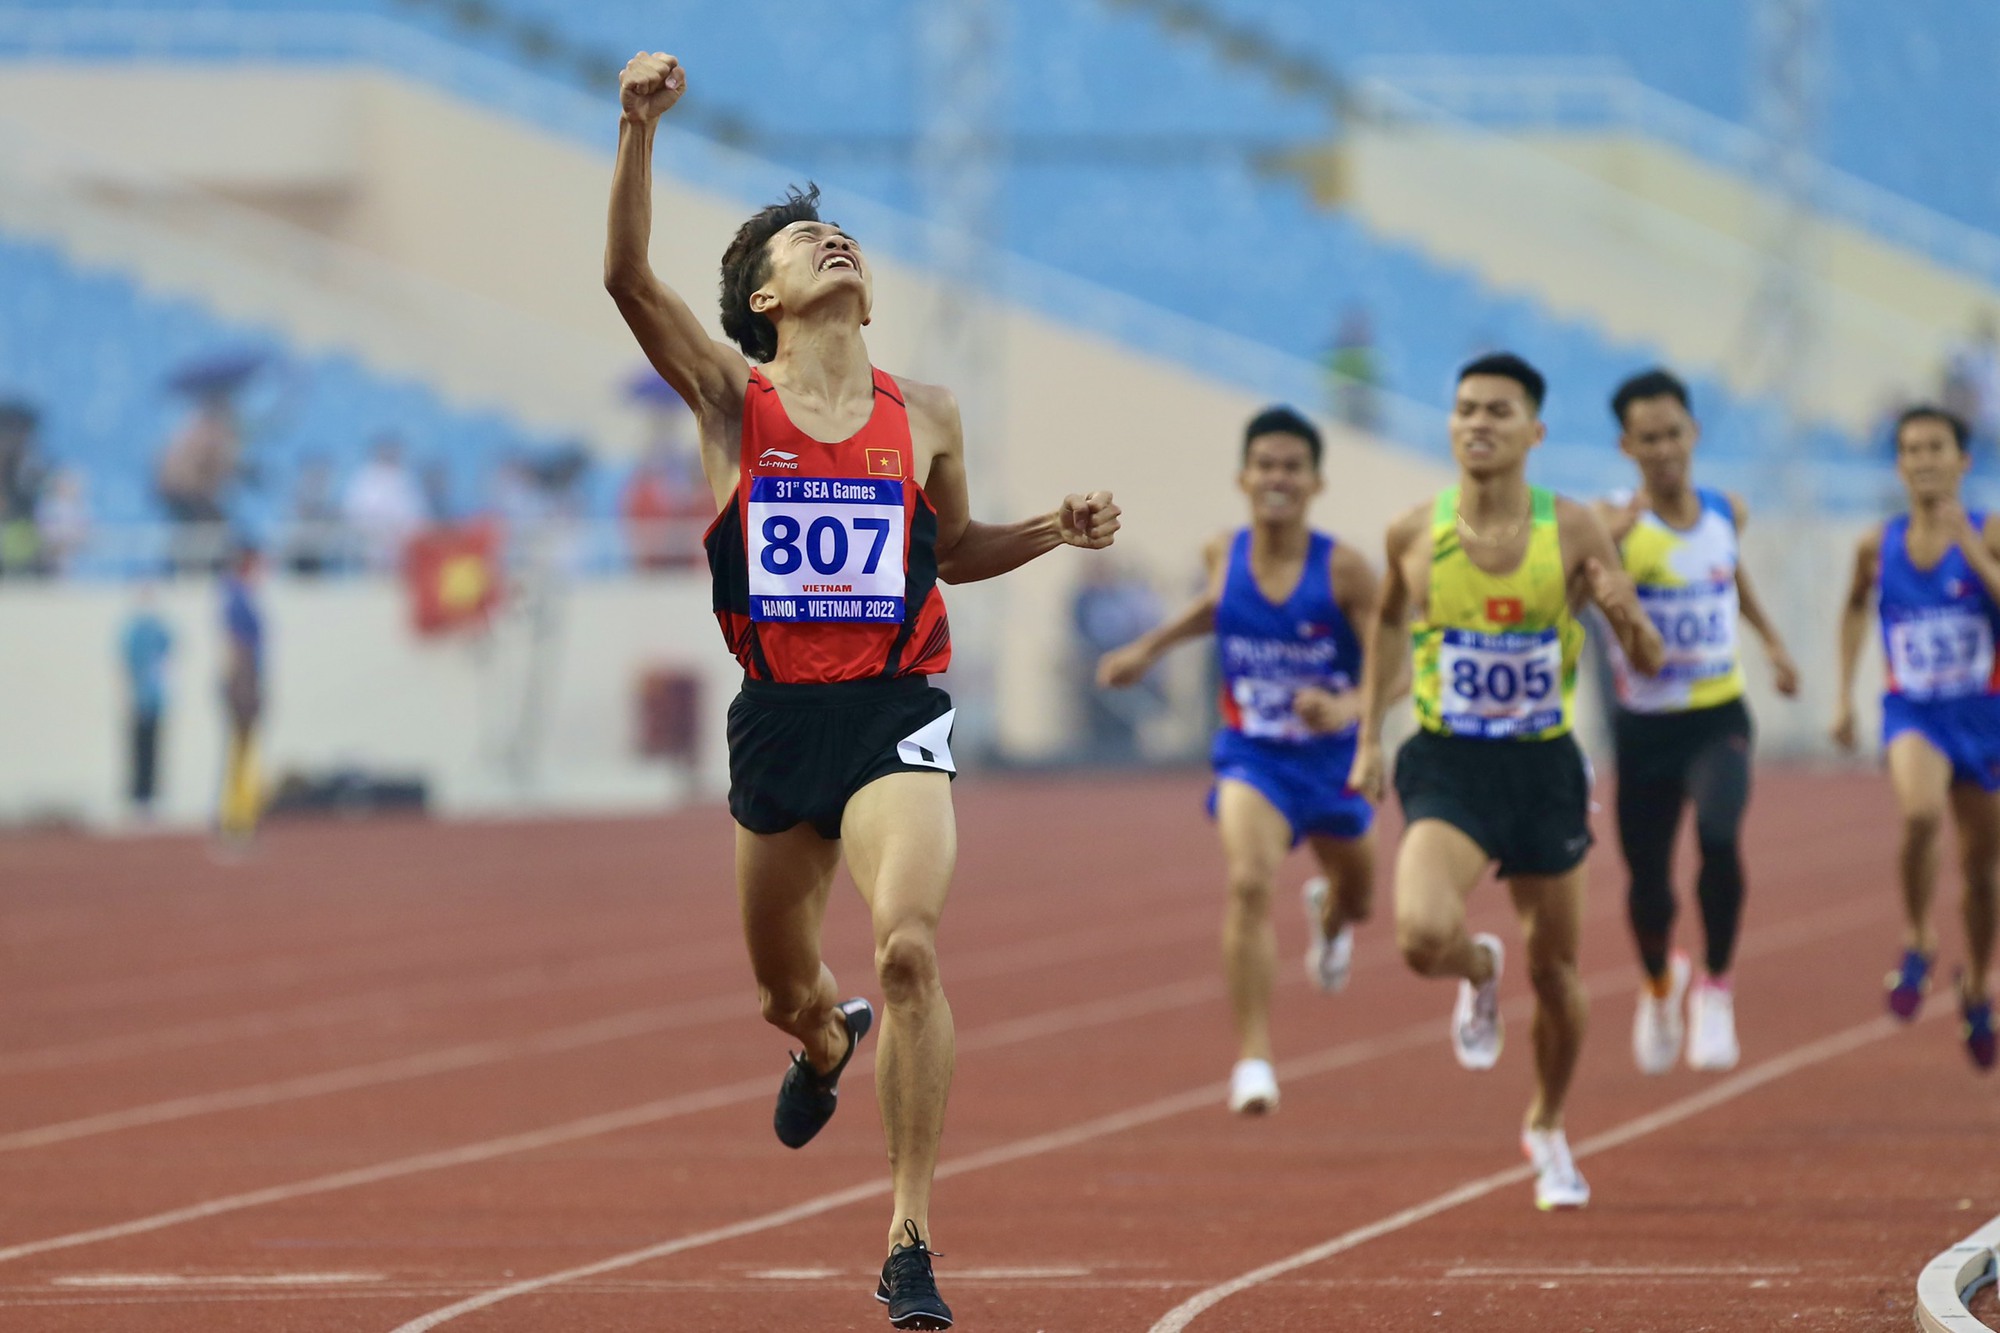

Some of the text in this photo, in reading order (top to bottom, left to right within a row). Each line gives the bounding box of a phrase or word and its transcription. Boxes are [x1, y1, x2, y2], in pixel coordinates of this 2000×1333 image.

[758, 460, 799, 470] LI-NING
[803, 481, 830, 499] SEA
[832, 482, 877, 500] Games
[760, 514, 891, 576] 807
[802, 584, 853, 593] VIETNAM
[761, 599, 797, 618] HANOI
[807, 600, 862, 619] VIETNAM
[865, 601, 896, 619] 2022
[1453, 657, 1553, 703] 805
